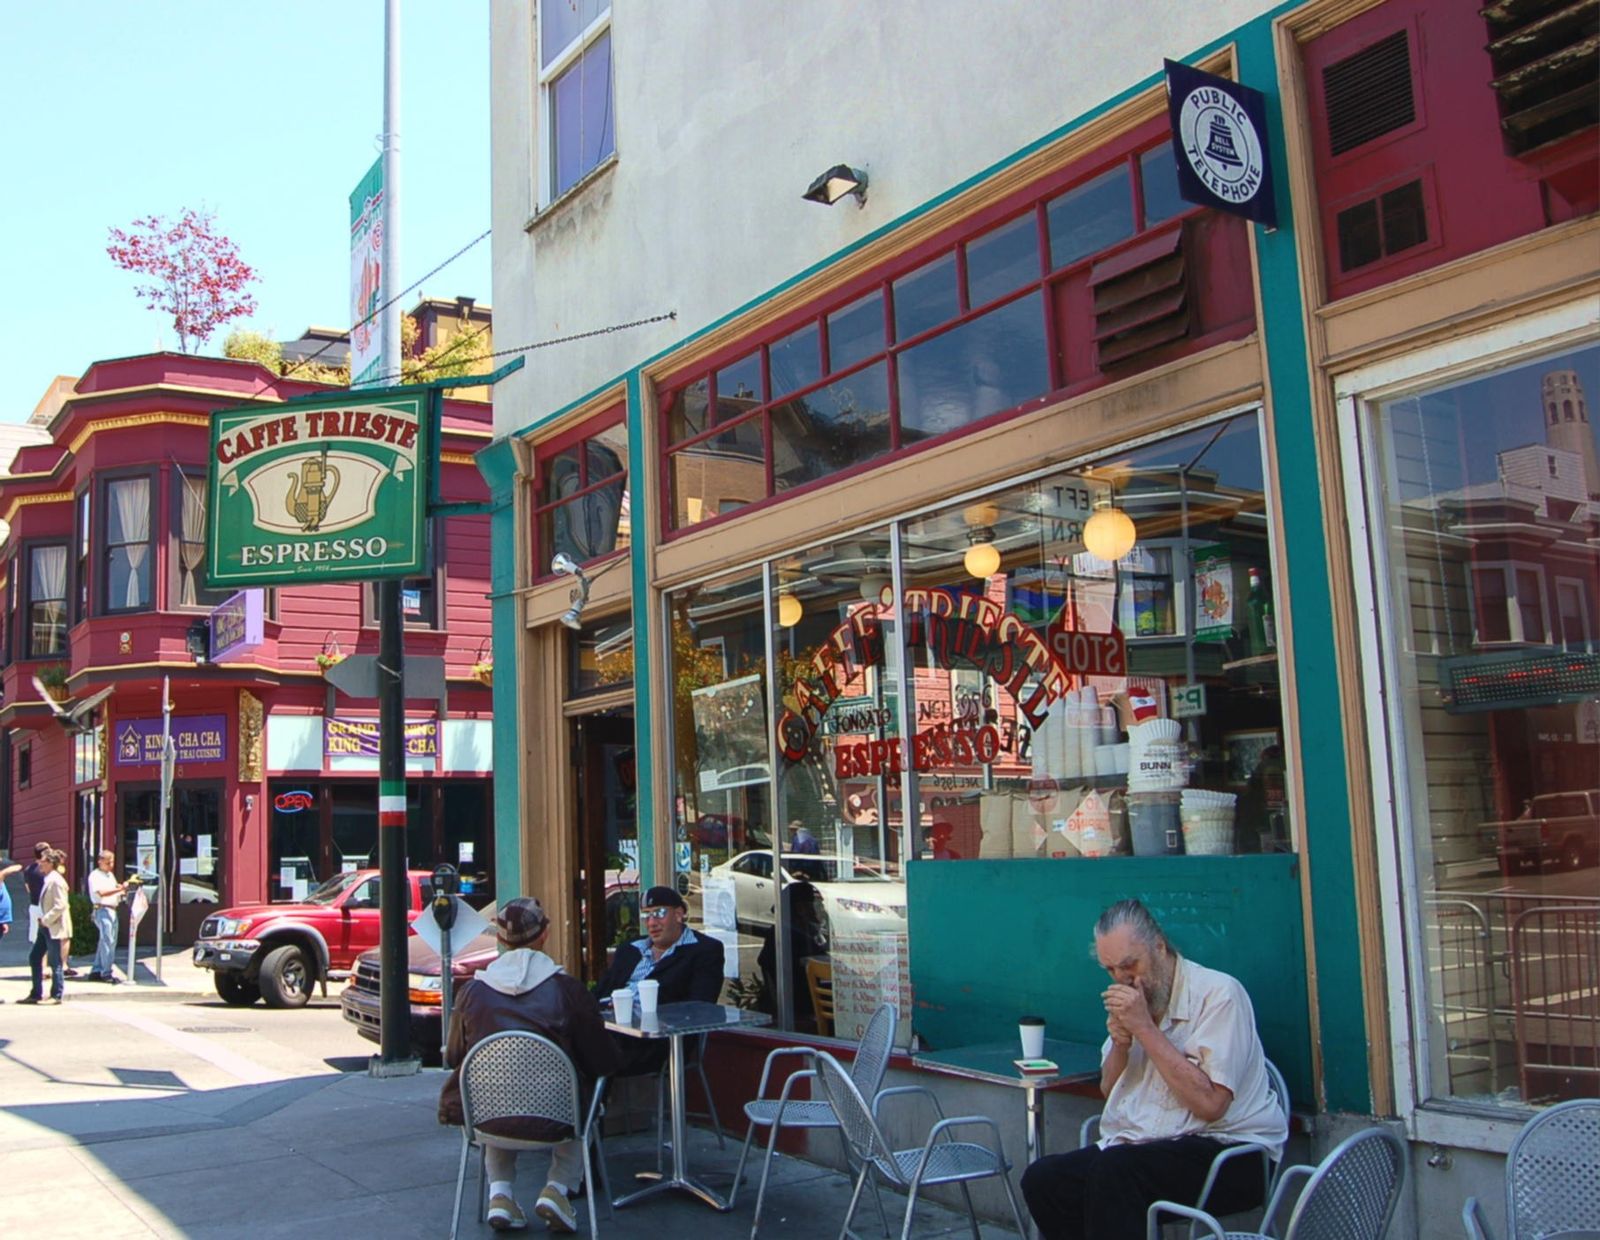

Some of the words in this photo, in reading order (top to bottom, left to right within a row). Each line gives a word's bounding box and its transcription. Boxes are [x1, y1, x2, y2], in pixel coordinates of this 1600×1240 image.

[1190, 89, 1247, 126] PUBLIC
[1211, 143, 1236, 157] SYSTEM
[1213, 135, 1231, 147] BELL
[1187, 143, 1260, 201] TELEPHONE
[216, 415, 299, 465] CAFFE
[305, 410, 421, 450] TRIESTE
[240, 536, 388, 567] ESPRESSO
[904, 585, 1073, 725] TRIESTE
[178, 732, 199, 747] CHA
[201, 731, 221, 746] CHA
[327, 736, 361, 753] KING
[408, 738, 436, 753] CHA
[834, 722, 1000, 781] ESPRESSO
[1140, 761, 1171, 771] BUNN
[274, 794, 312, 809] OPEN
